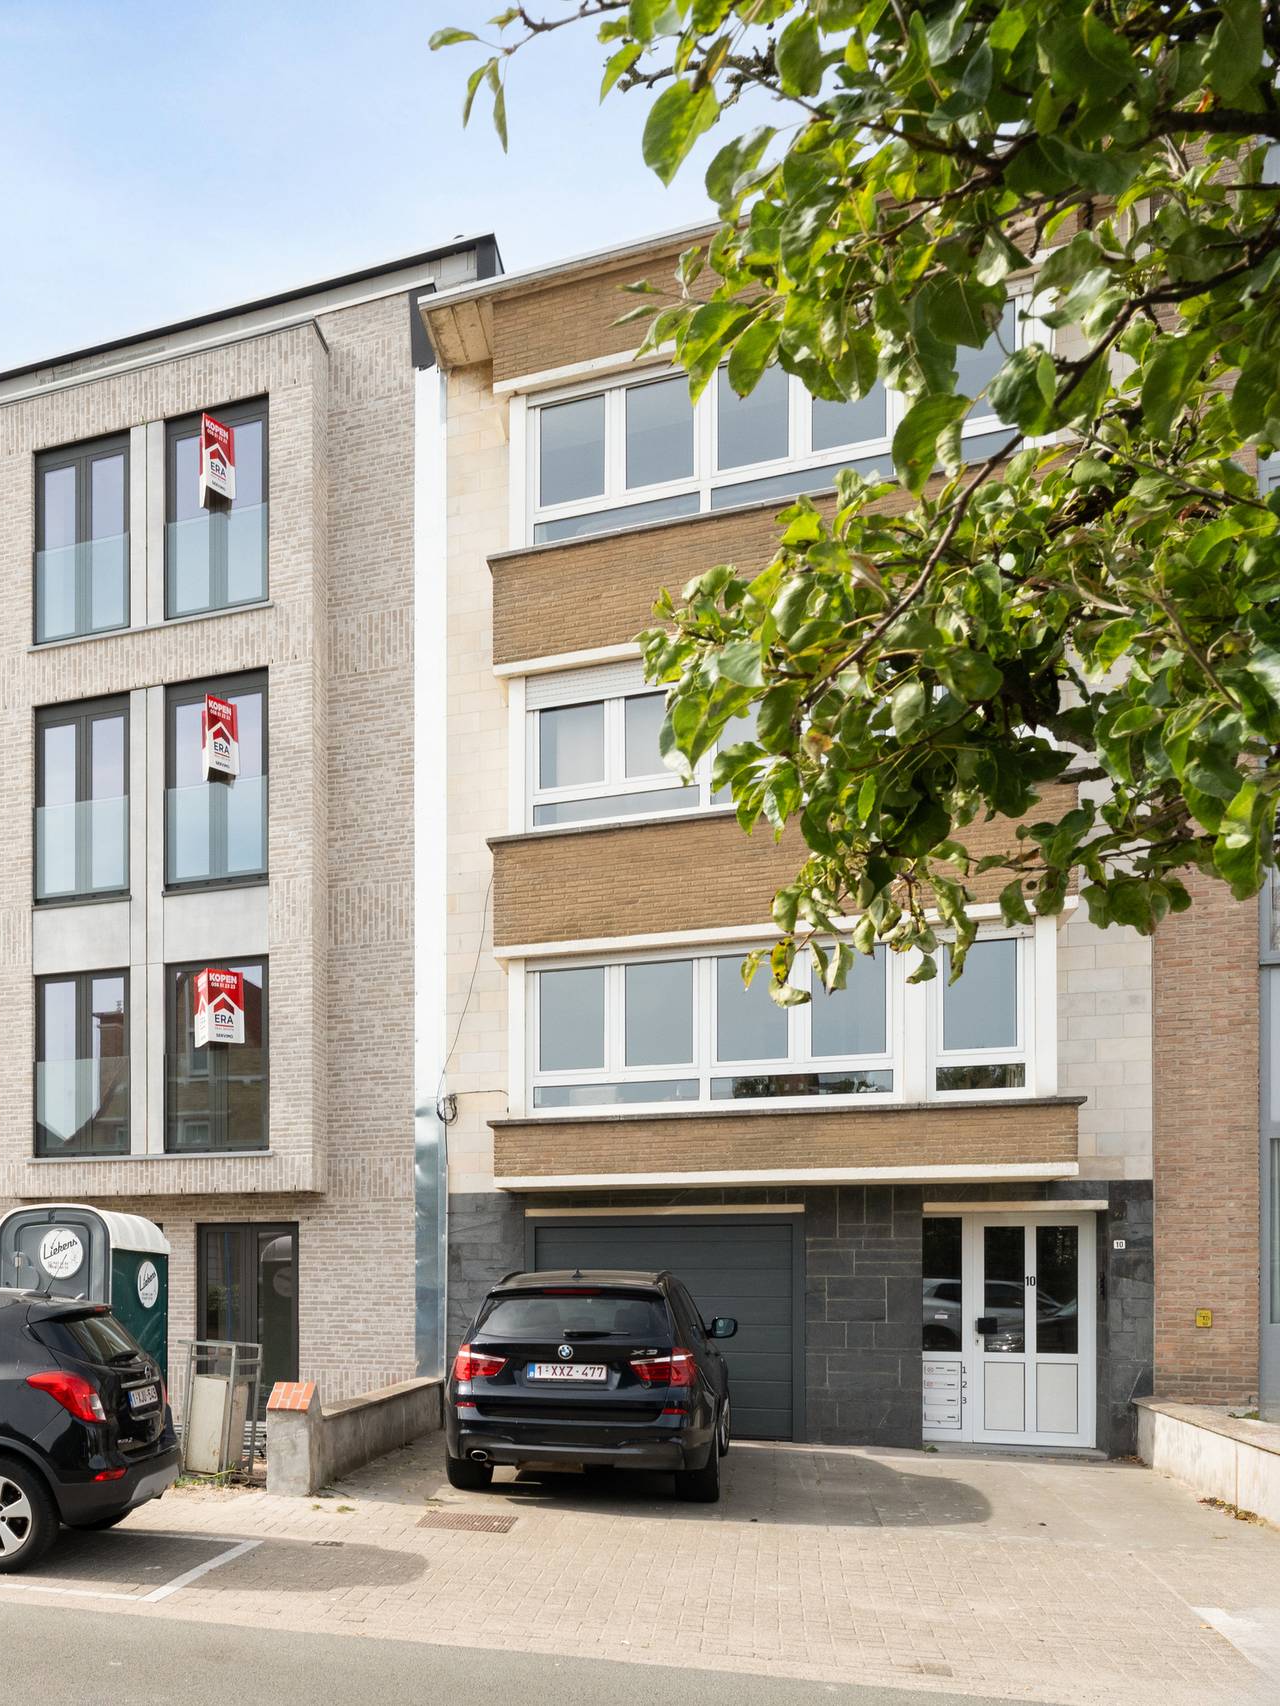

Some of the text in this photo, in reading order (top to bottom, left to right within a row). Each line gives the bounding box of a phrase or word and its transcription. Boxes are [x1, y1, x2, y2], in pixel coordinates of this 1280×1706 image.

[205, 418, 229, 440] KOPEN
[210, 461, 227, 478] ERA
[208, 698, 232, 716] KOPEN
[213, 741, 230, 754] ERA
[209, 972, 237, 985] KOPEN
[214, 1014, 234, 1025] ERA
[1025, 1275, 1036, 1286] 10
[962, 1366, 967, 1374] 1
[962, 1396, 968, 1404] 3
